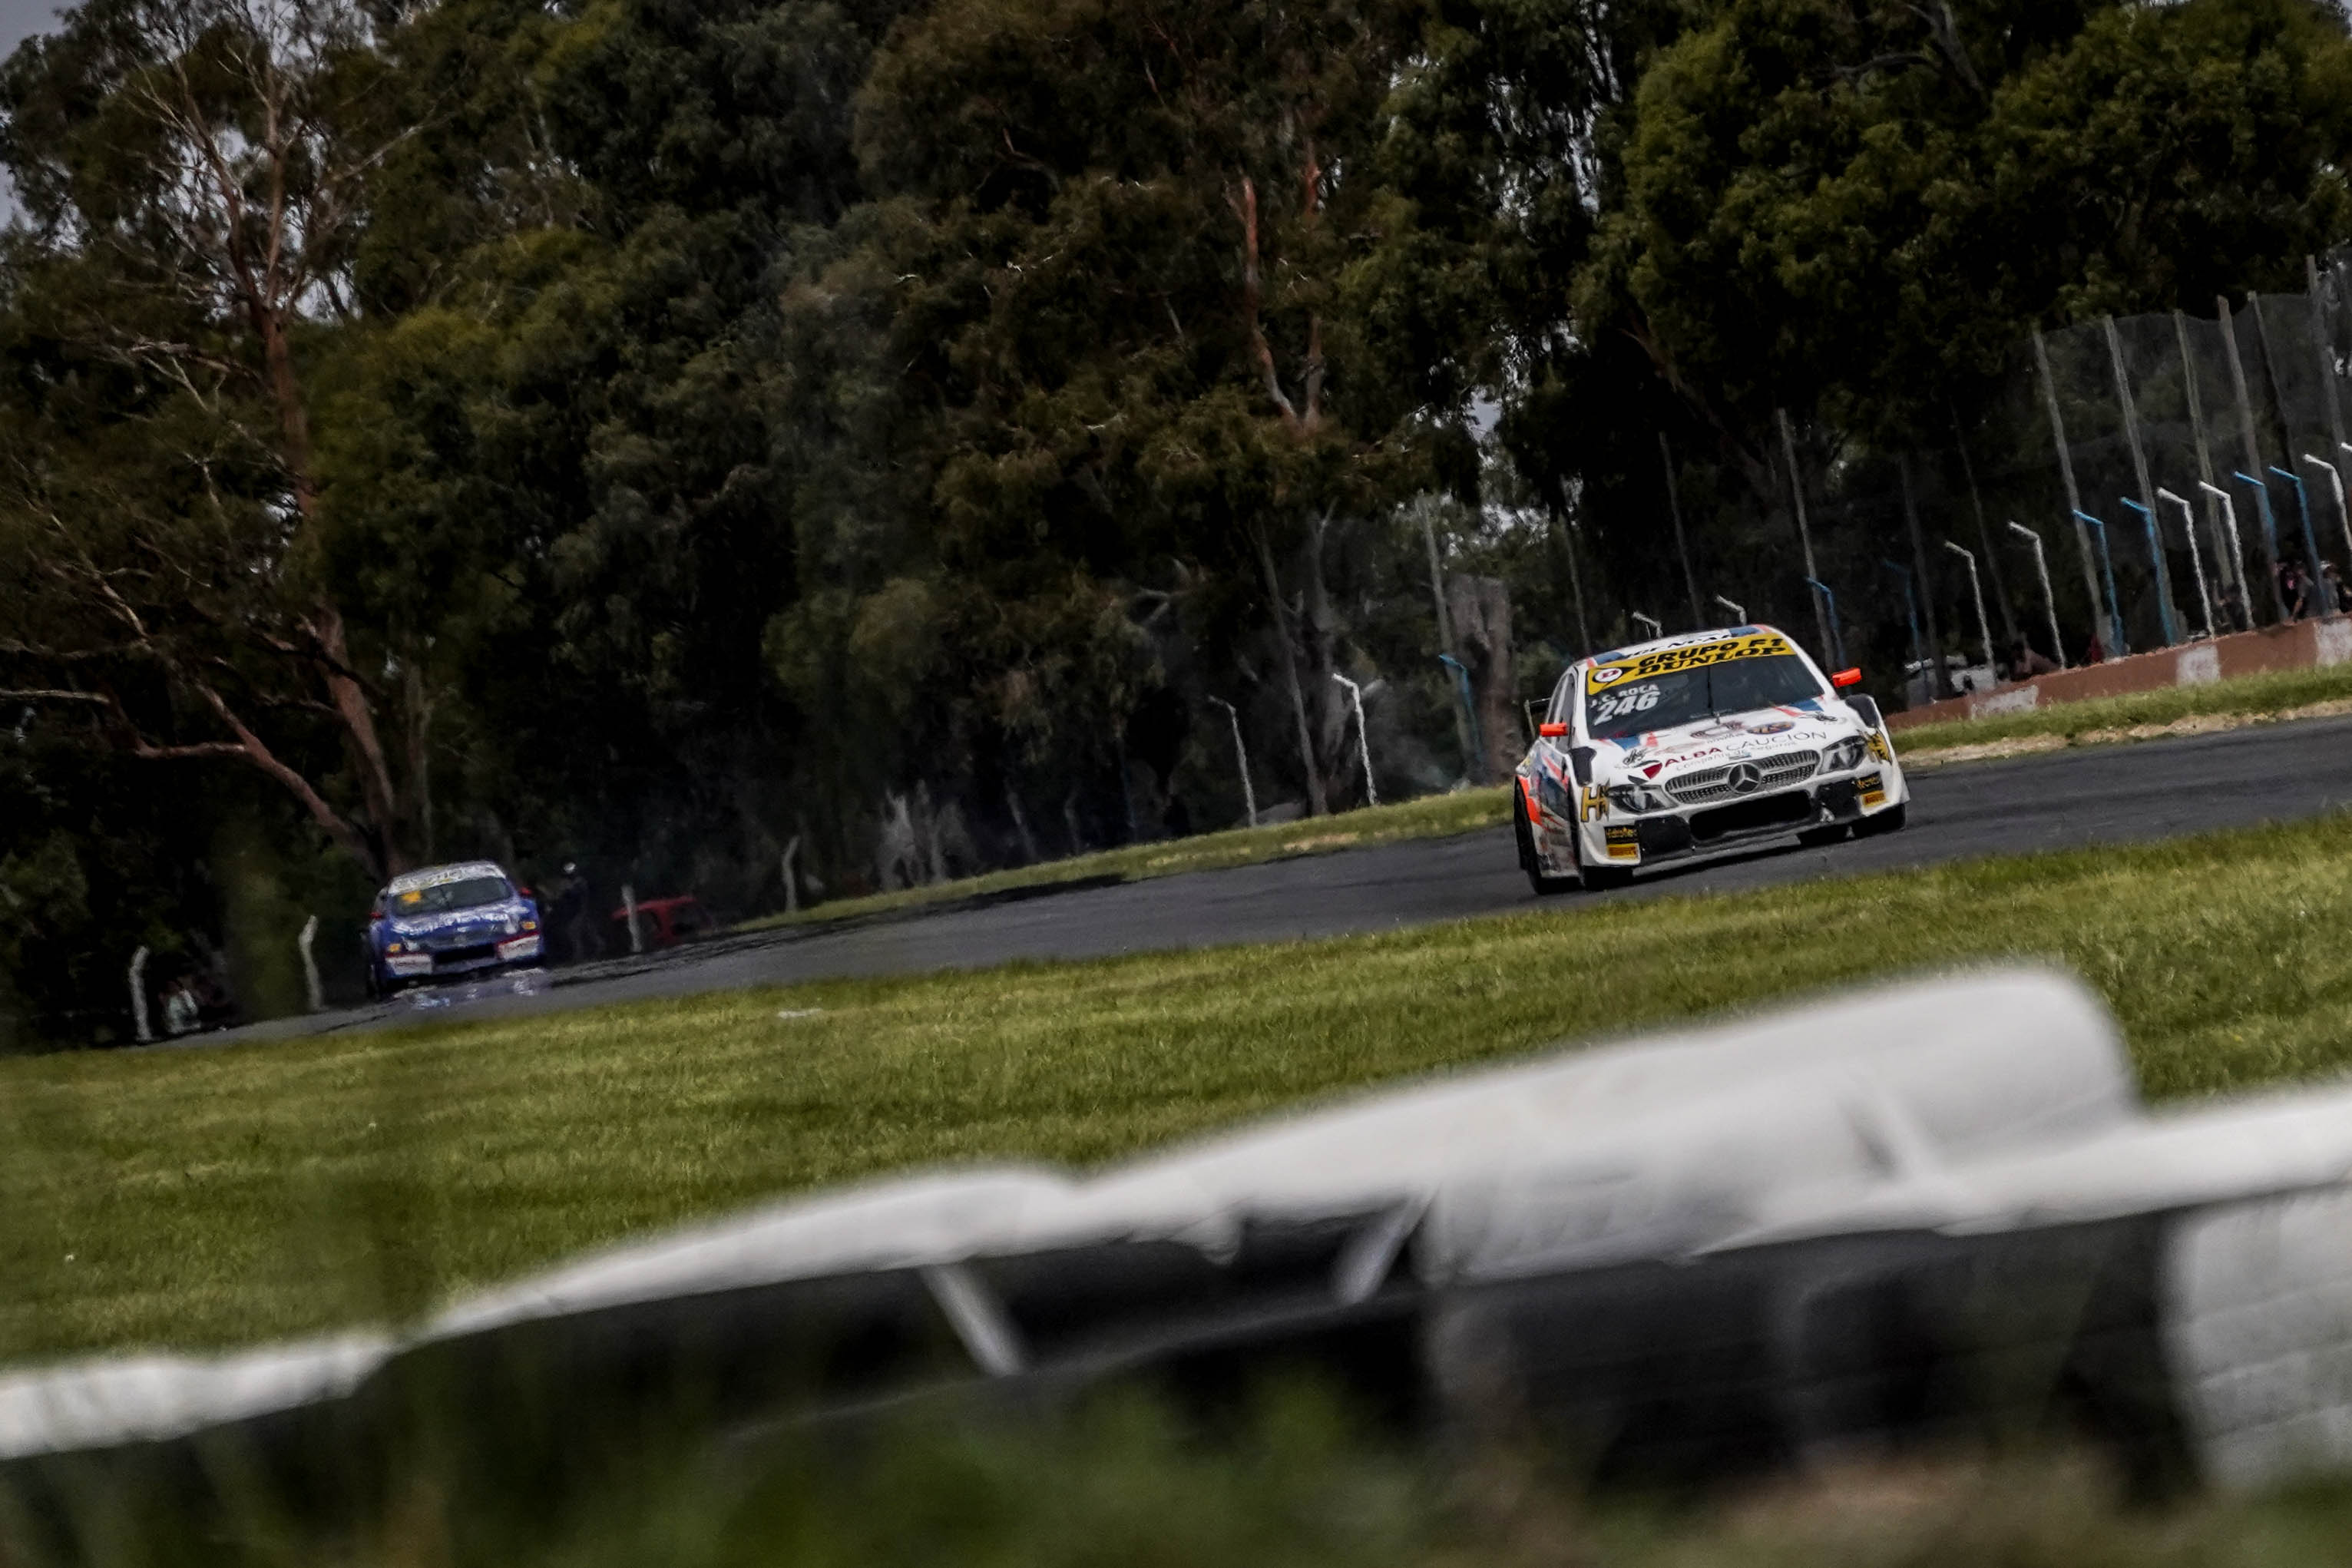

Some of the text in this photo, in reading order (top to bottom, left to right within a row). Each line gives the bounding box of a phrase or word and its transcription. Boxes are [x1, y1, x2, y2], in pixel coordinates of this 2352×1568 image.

[1636, 647, 1786, 676] DUNLOP
[1639, 642, 1734, 667] GRUPO
[1748, 638, 1784, 647] F1
[1618, 684, 1659, 696] ROCA
[1593, 691, 1661, 726] 246
[1665, 747, 1722, 767] ALBA
